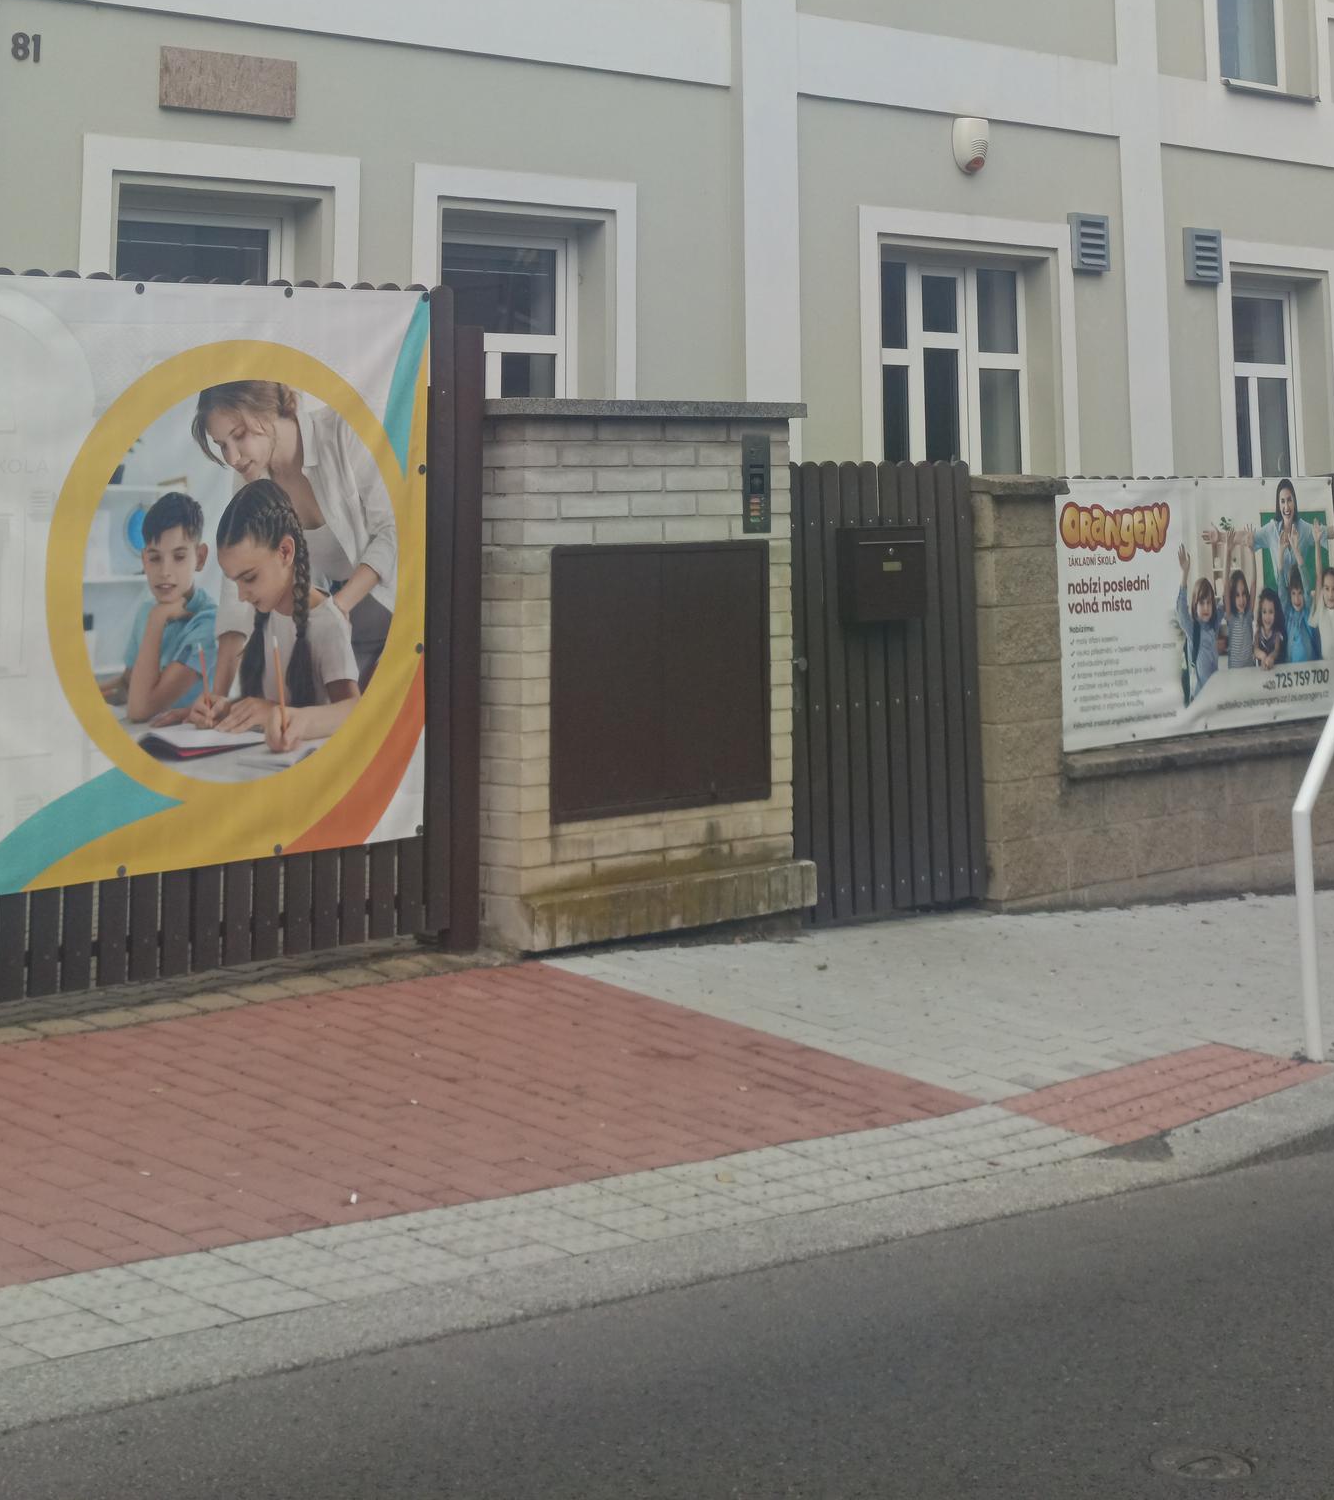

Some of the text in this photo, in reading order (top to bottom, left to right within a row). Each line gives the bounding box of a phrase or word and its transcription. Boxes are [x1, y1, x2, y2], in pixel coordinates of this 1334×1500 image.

[10, 31, 42, 63] 81
[1067, 574, 1150, 597] nabízí poslední
[1068, 595, 1132, 615] volná místa
[1275, 672, 1293, 689] 725
[1294, 670, 1310, 687] 759
[1311, 668, 1330, 685] 700
